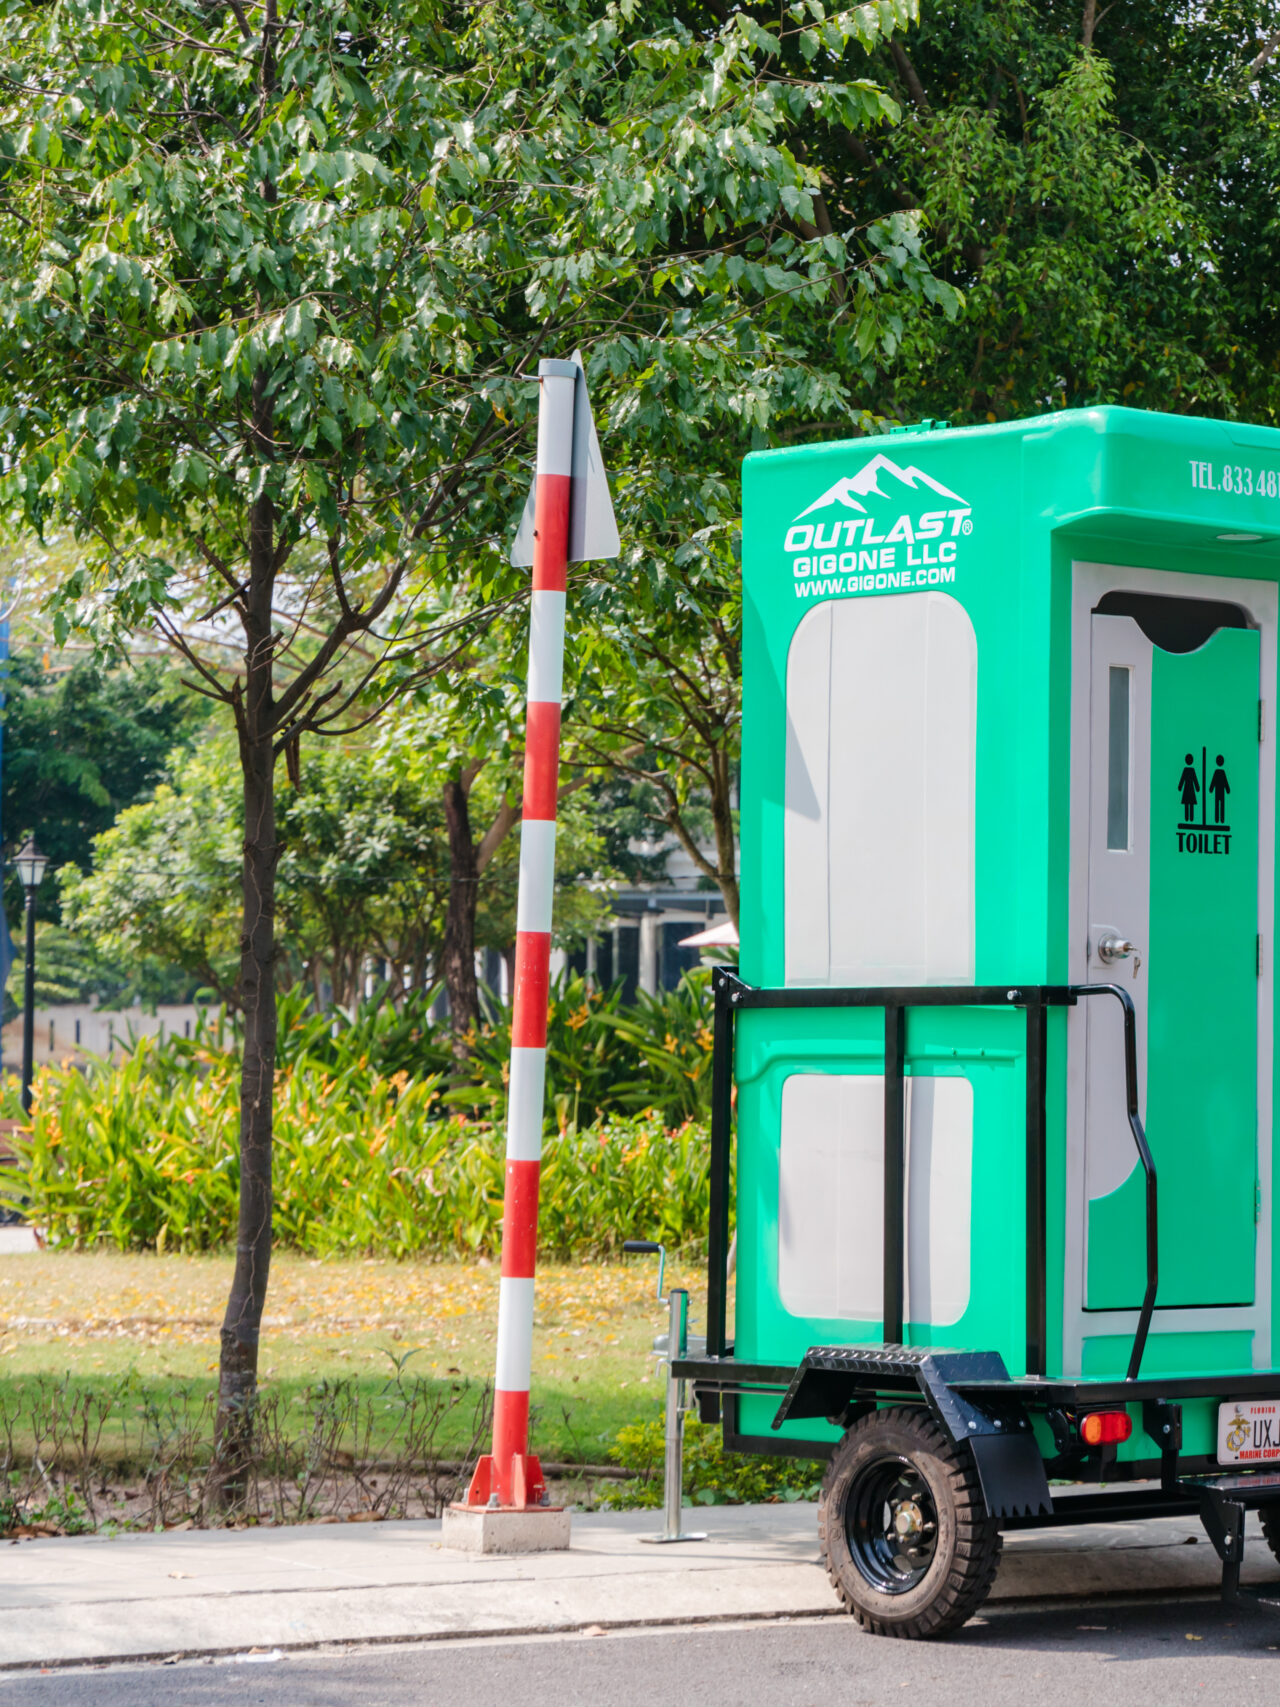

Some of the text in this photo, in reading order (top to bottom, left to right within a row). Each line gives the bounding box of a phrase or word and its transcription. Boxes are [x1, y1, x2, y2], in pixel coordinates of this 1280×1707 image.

[792, 541, 957, 578] GIGONE LLC
[794, 567, 956, 598] WWW.GIGONE.COM
[1176, 833, 1232, 854] TOILET
[1239, 1450, 1262, 1460] MARINE
